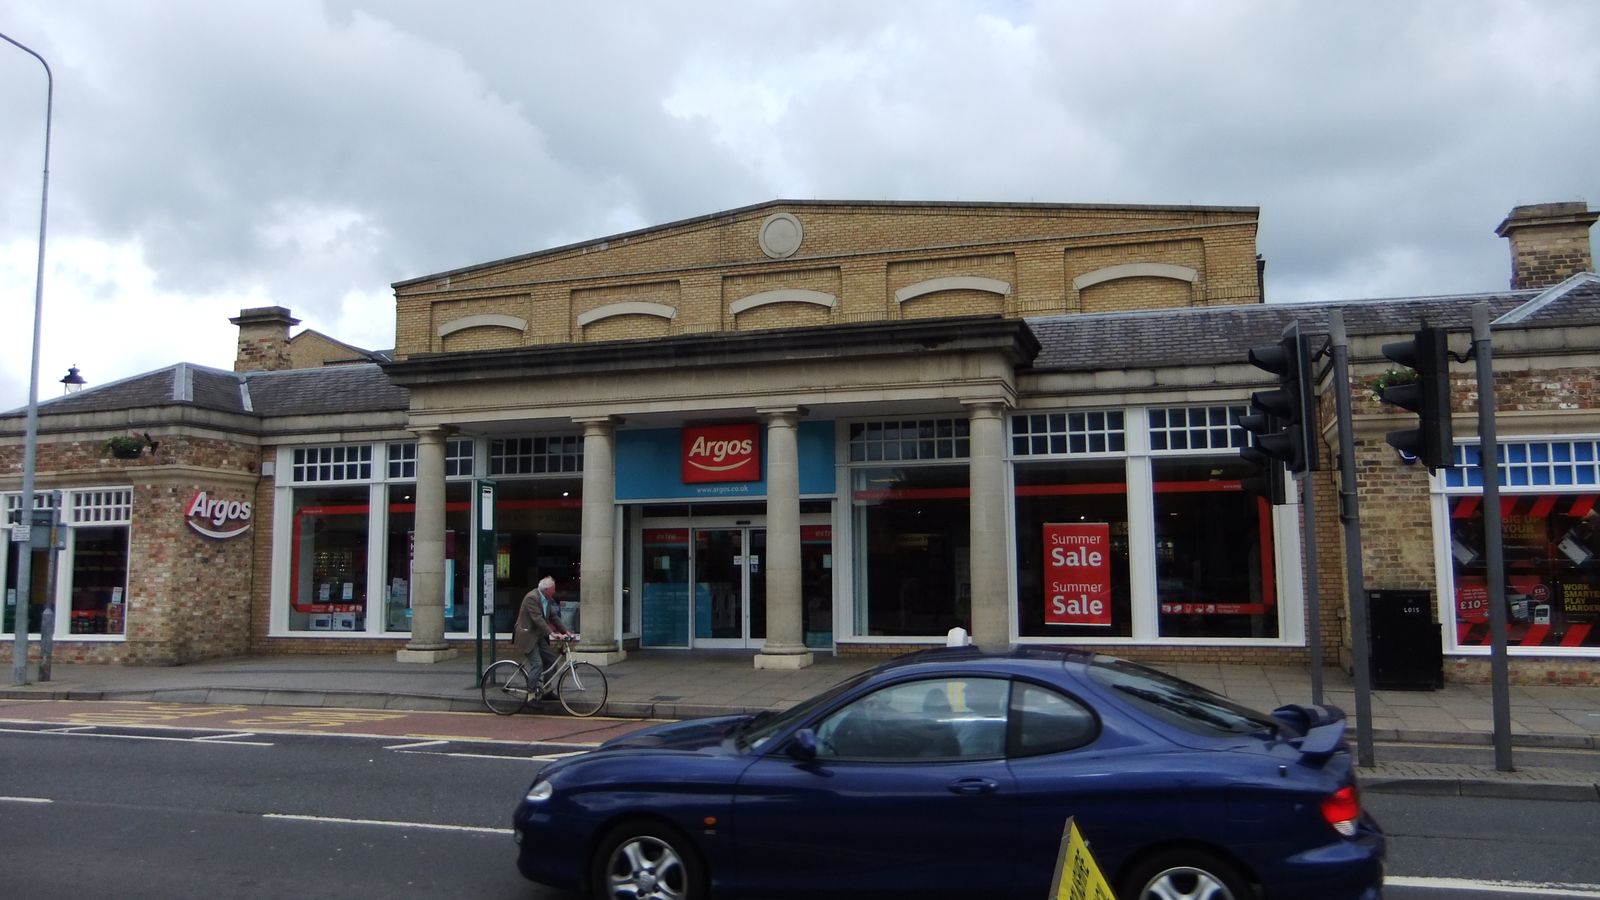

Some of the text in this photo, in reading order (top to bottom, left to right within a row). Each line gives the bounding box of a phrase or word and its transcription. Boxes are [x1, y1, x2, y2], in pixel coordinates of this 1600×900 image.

[688, 436, 752, 462] Argos
[696, 485, 749, 494] www.argos.co.uk
[188, 491, 252, 526] Argos
[1051, 534, 1101, 545] Summer
[1051, 547, 1102, 567] Sale
[1052, 581, 1102, 593] Summer
[1563, 583, 1590, 591] WORK
[1564, 590, 1600, 598] SMARTE
[1052, 595, 1103, 615] Sale
[1460, 600, 1481, 610] £10
[1564, 597, 1585, 605] PLAY
